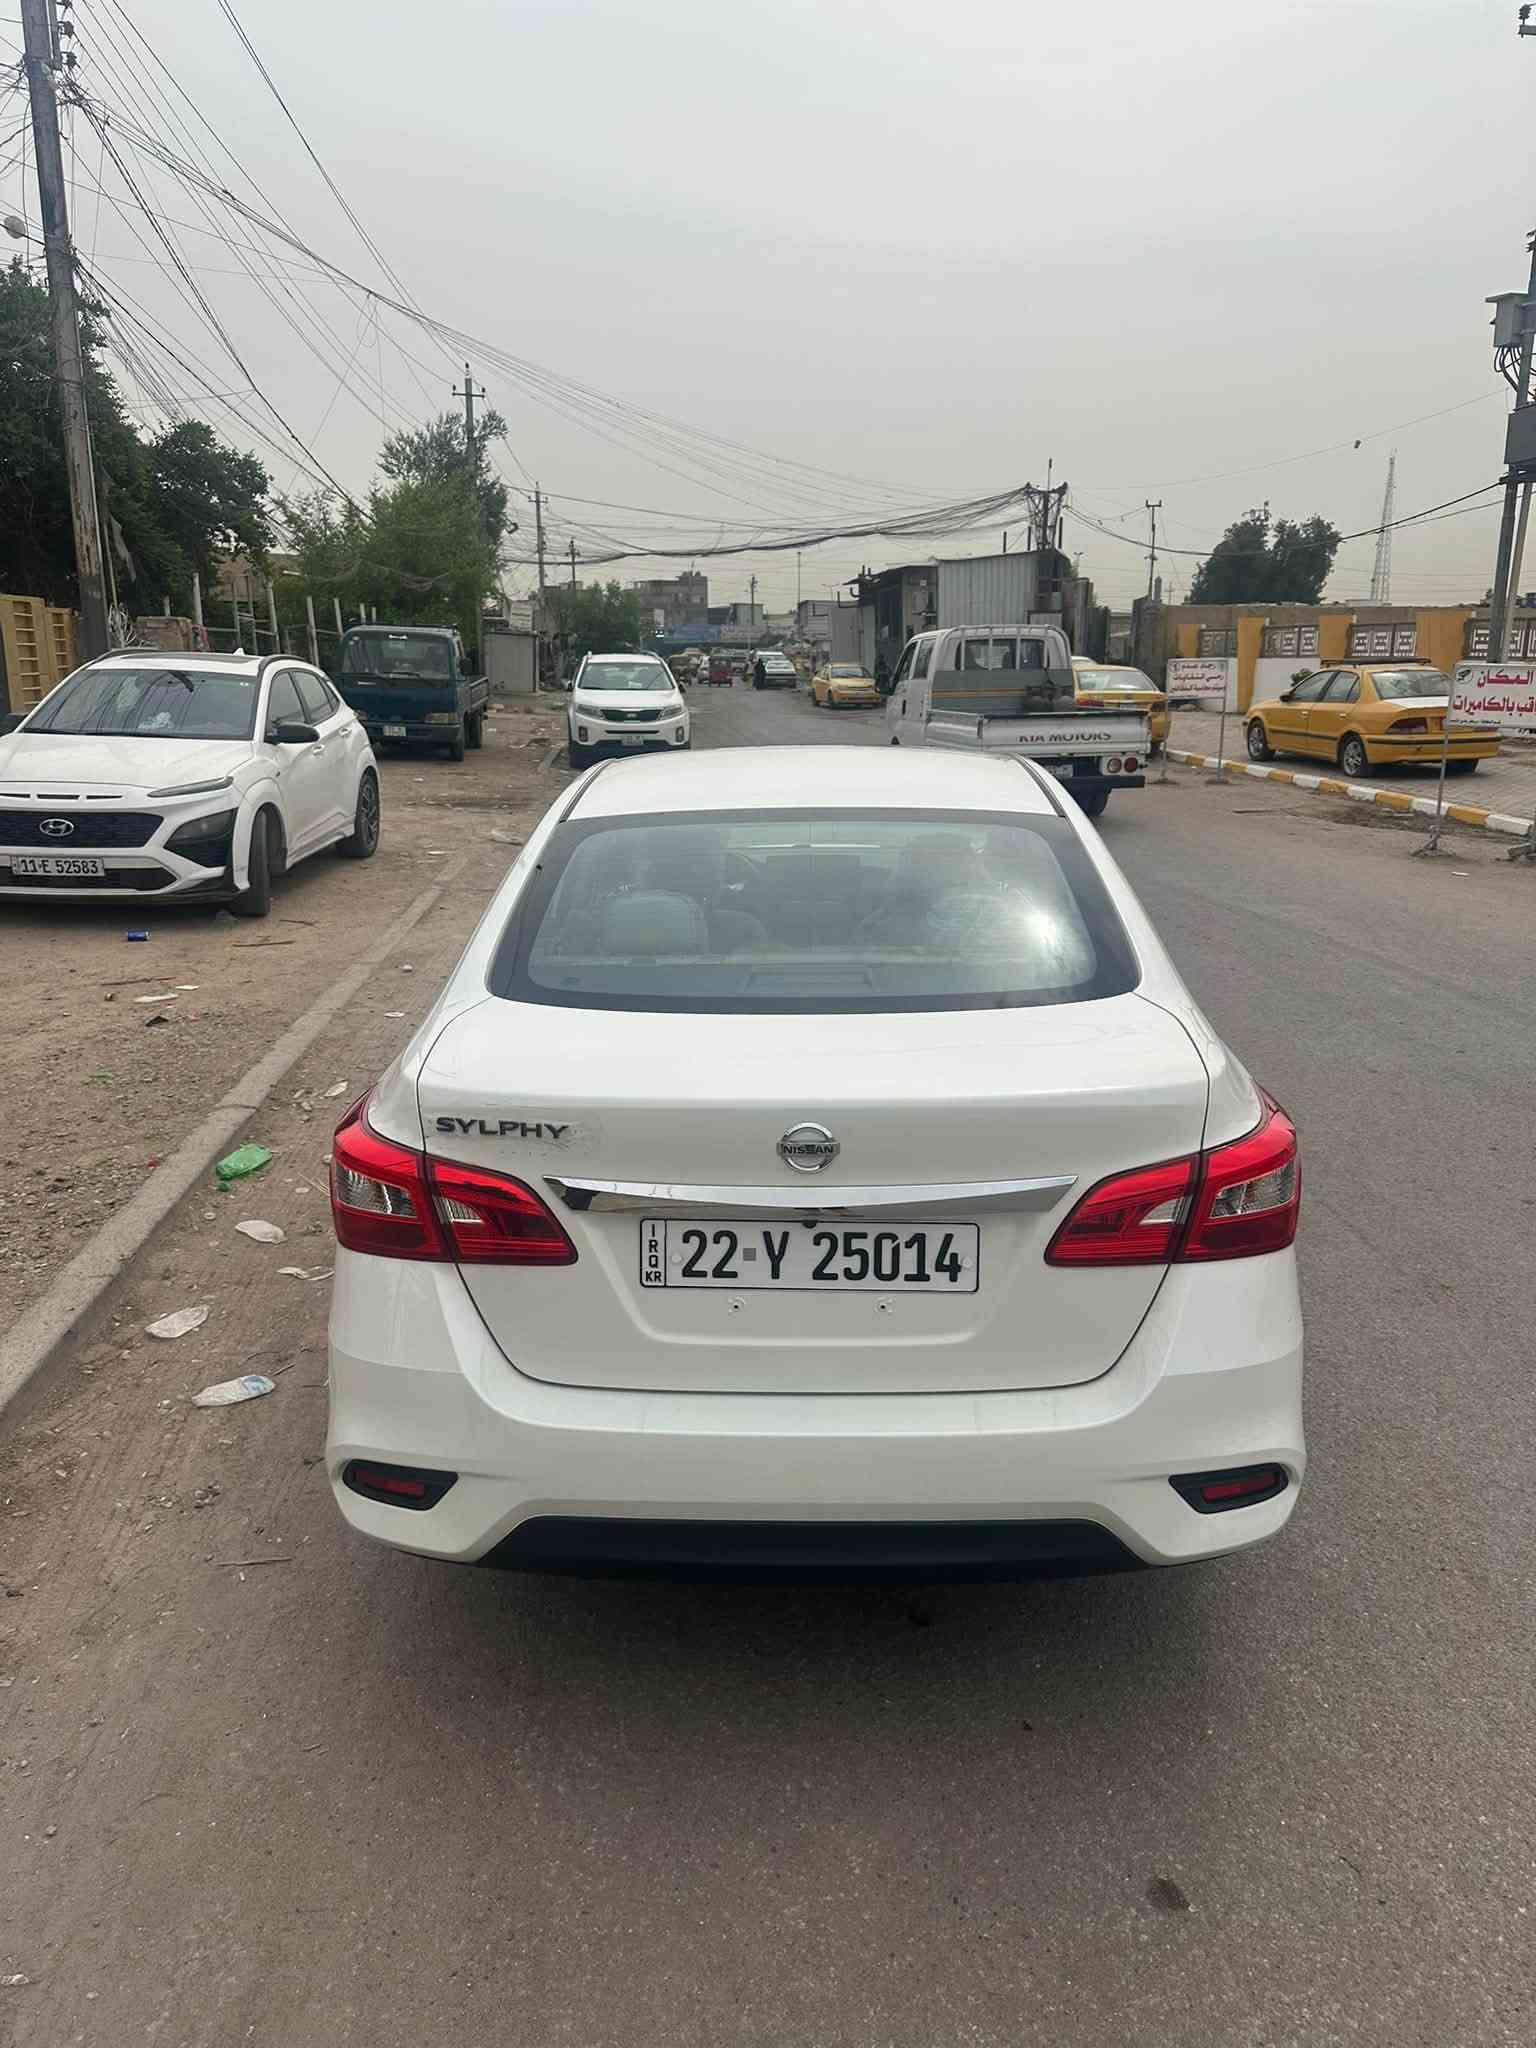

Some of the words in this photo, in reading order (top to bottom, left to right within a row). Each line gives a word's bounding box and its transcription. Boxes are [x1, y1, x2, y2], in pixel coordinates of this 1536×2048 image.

[1476, 668, 1534, 689] المكان
[1452, 695, 1516, 716] بالكاميرات
[1048, 731, 1112, 743] MOTORS
[20, 858, 39, 873] 11
[55, 859, 98, 874] 52583
[435, 1117, 568, 1140] SYLPHY
[782, 1142, 835, 1157] NISSAN
[648, 1223, 660, 1269] IRQ
[681, 1229, 739, 1279] 22
[763, 1230, 790, 1280] Y
[811, 1231, 962, 1283] 25014
[645, 1270, 662, 1283] KR
